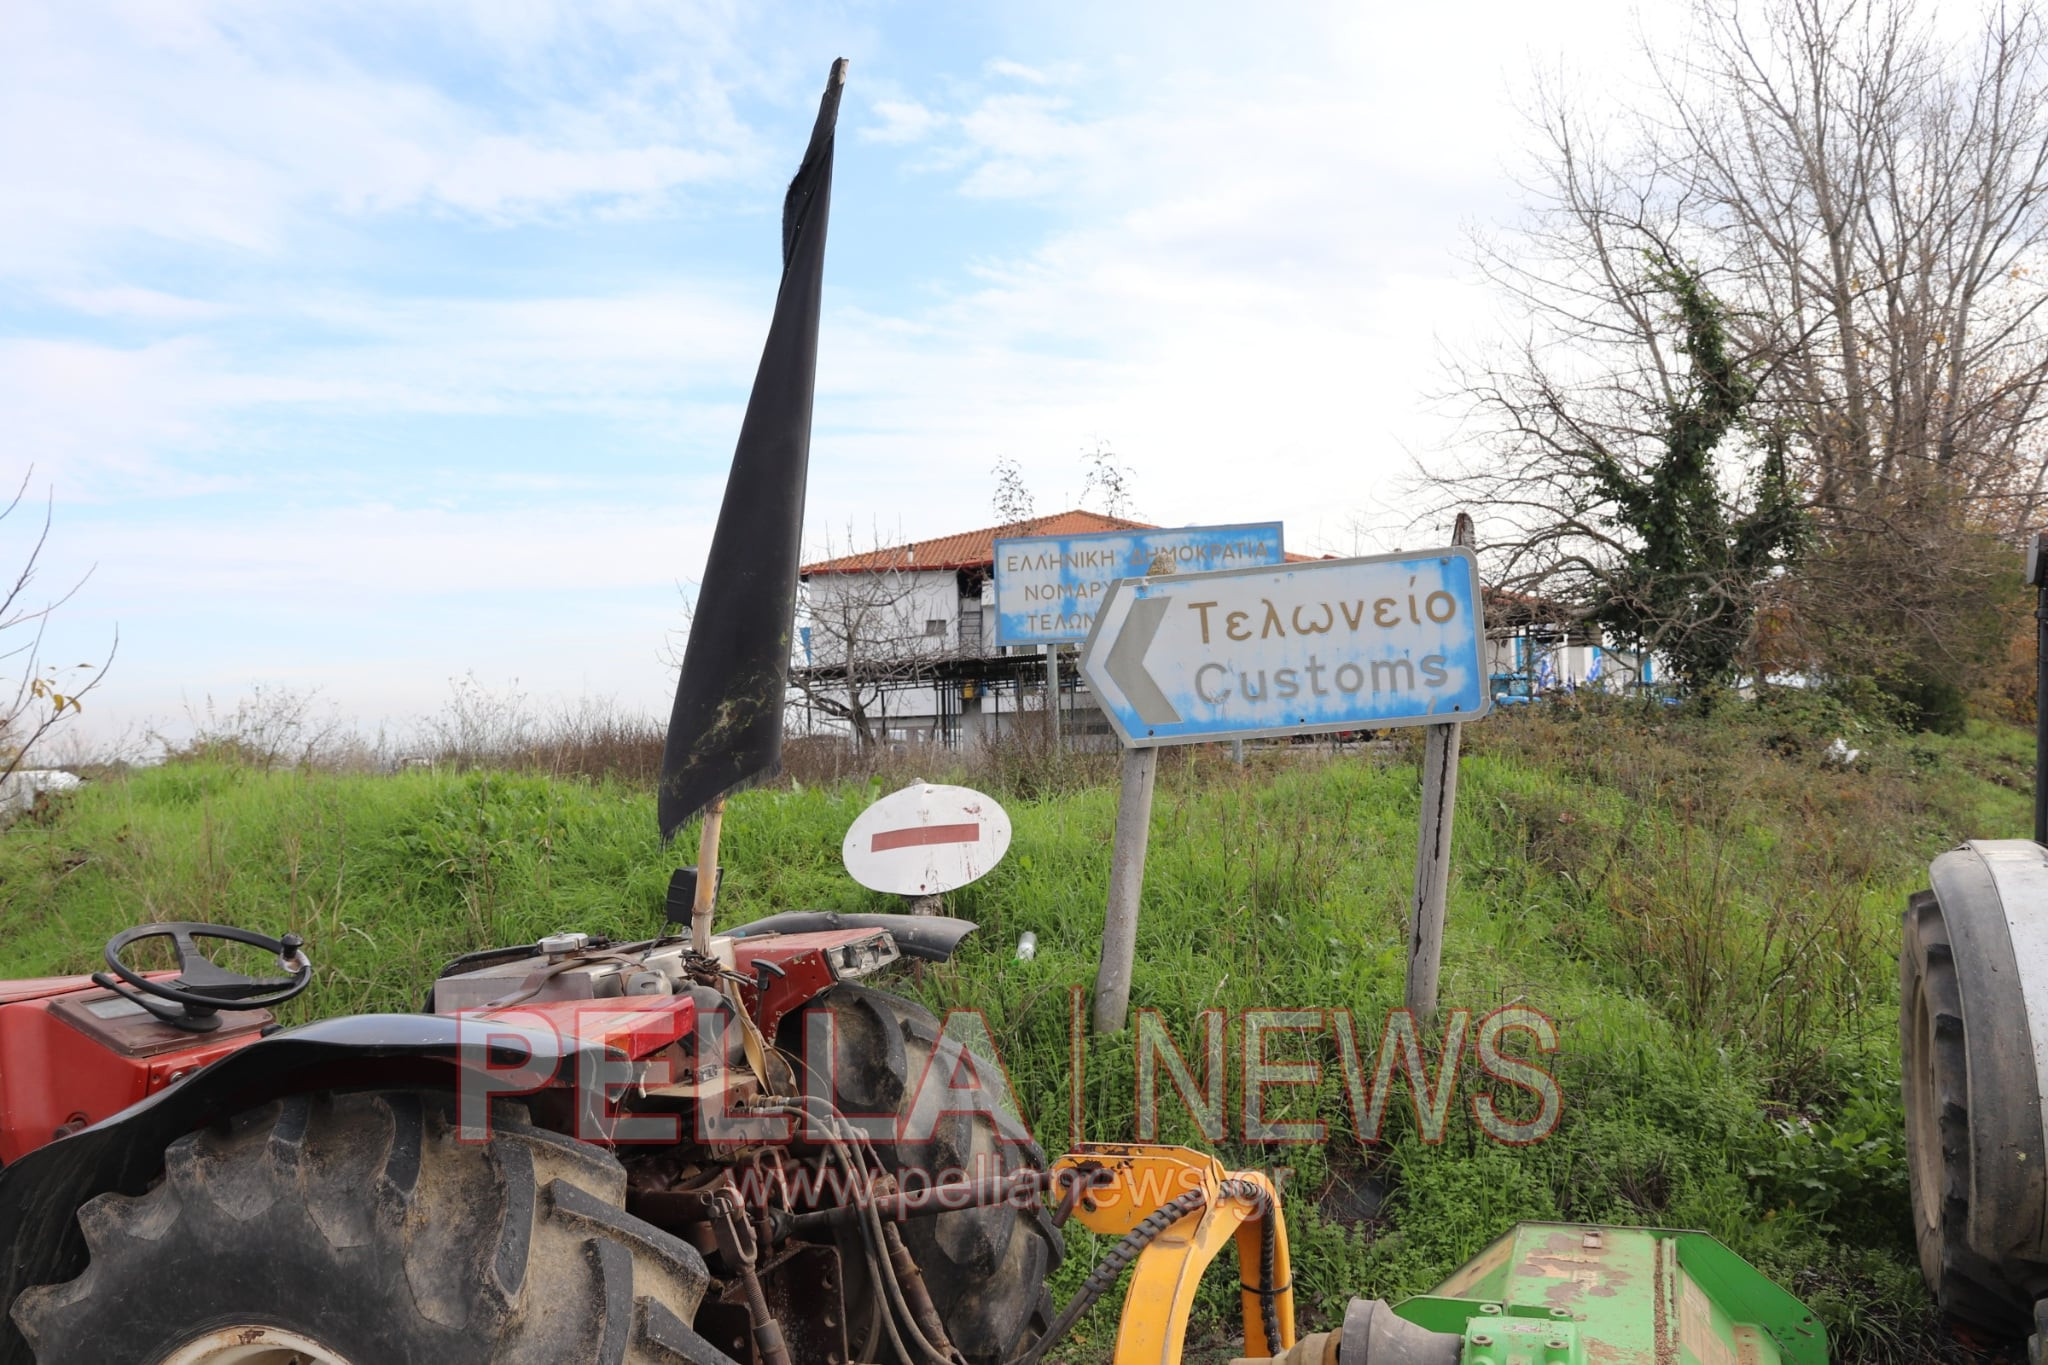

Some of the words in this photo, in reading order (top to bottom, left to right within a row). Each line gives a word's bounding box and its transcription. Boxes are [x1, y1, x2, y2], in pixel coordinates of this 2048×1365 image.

[1007, 549, 1115, 572] ΕΛΛΗΝΙΚΗ
[1187, 575, 1457, 645] Τελωνείο
[1194, 654, 1450, 705] Customs
